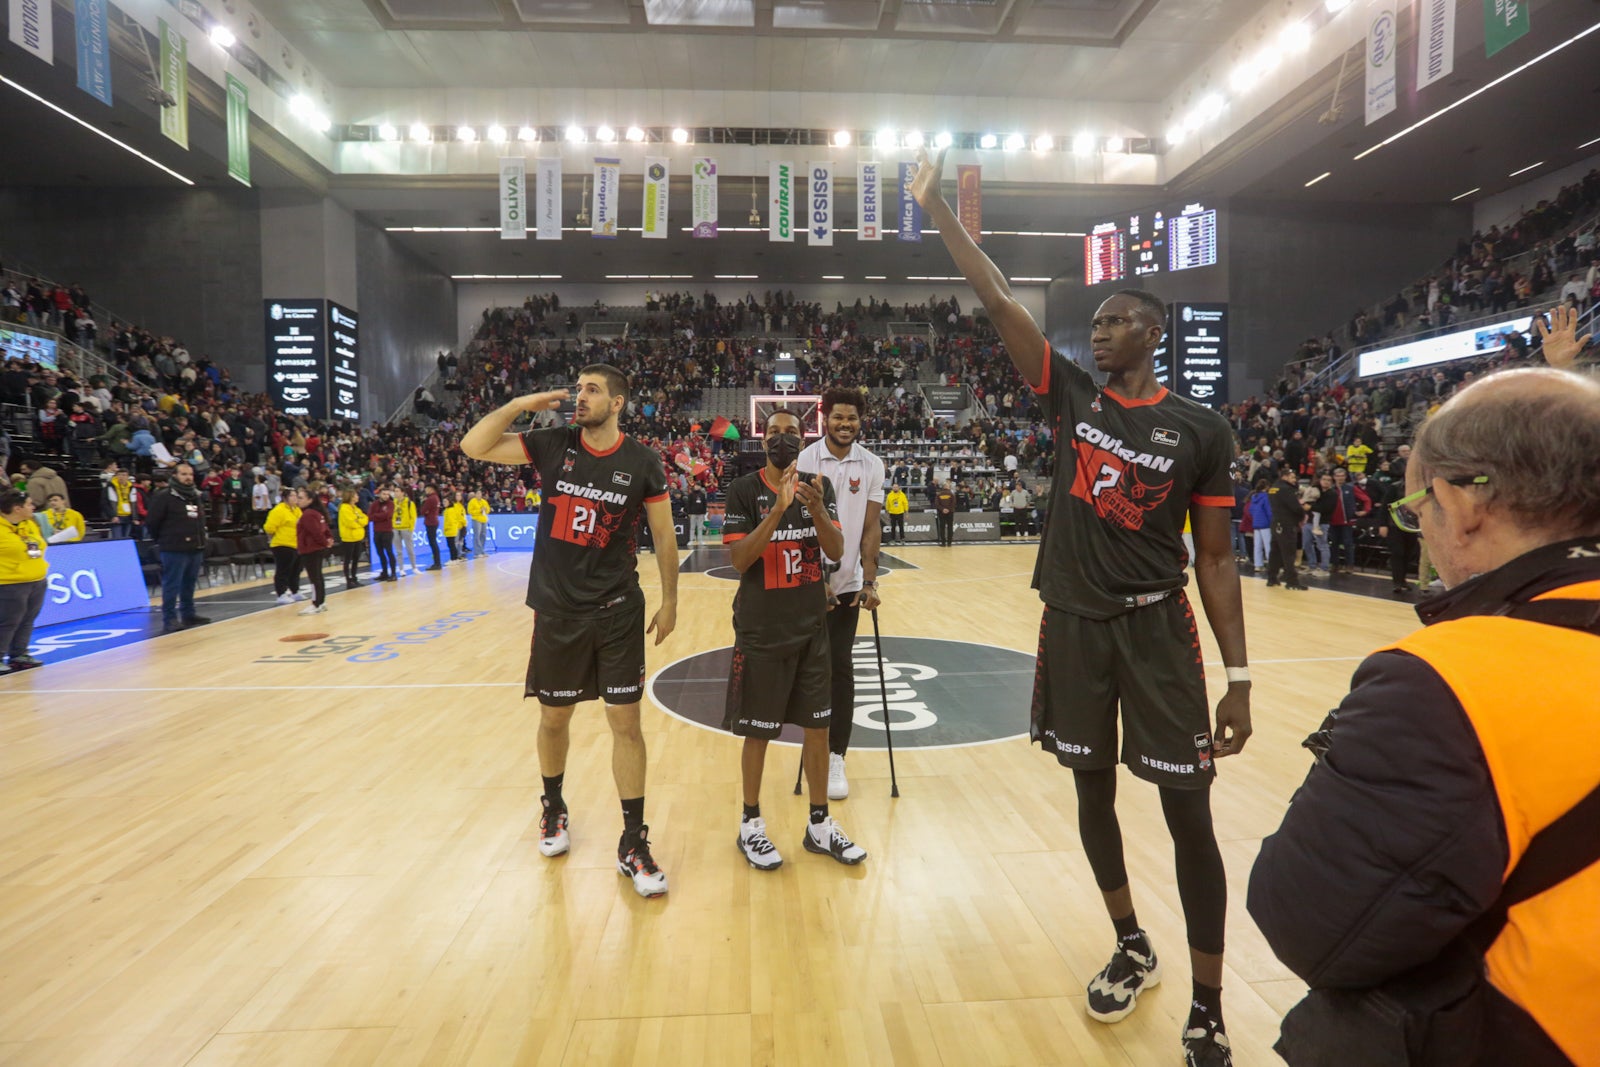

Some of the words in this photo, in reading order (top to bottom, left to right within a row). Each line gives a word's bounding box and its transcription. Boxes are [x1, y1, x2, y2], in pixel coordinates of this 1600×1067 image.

[598, 167, 608, 223] aeroprint
[864, 165, 876, 222] BERNER
[903, 204, 913, 231] Mica
[572, 505, 597, 534] 21
[783, 549, 802, 575] 12
[346, 610, 490, 663] endesa
[1149, 758, 1195, 774] BERNER
